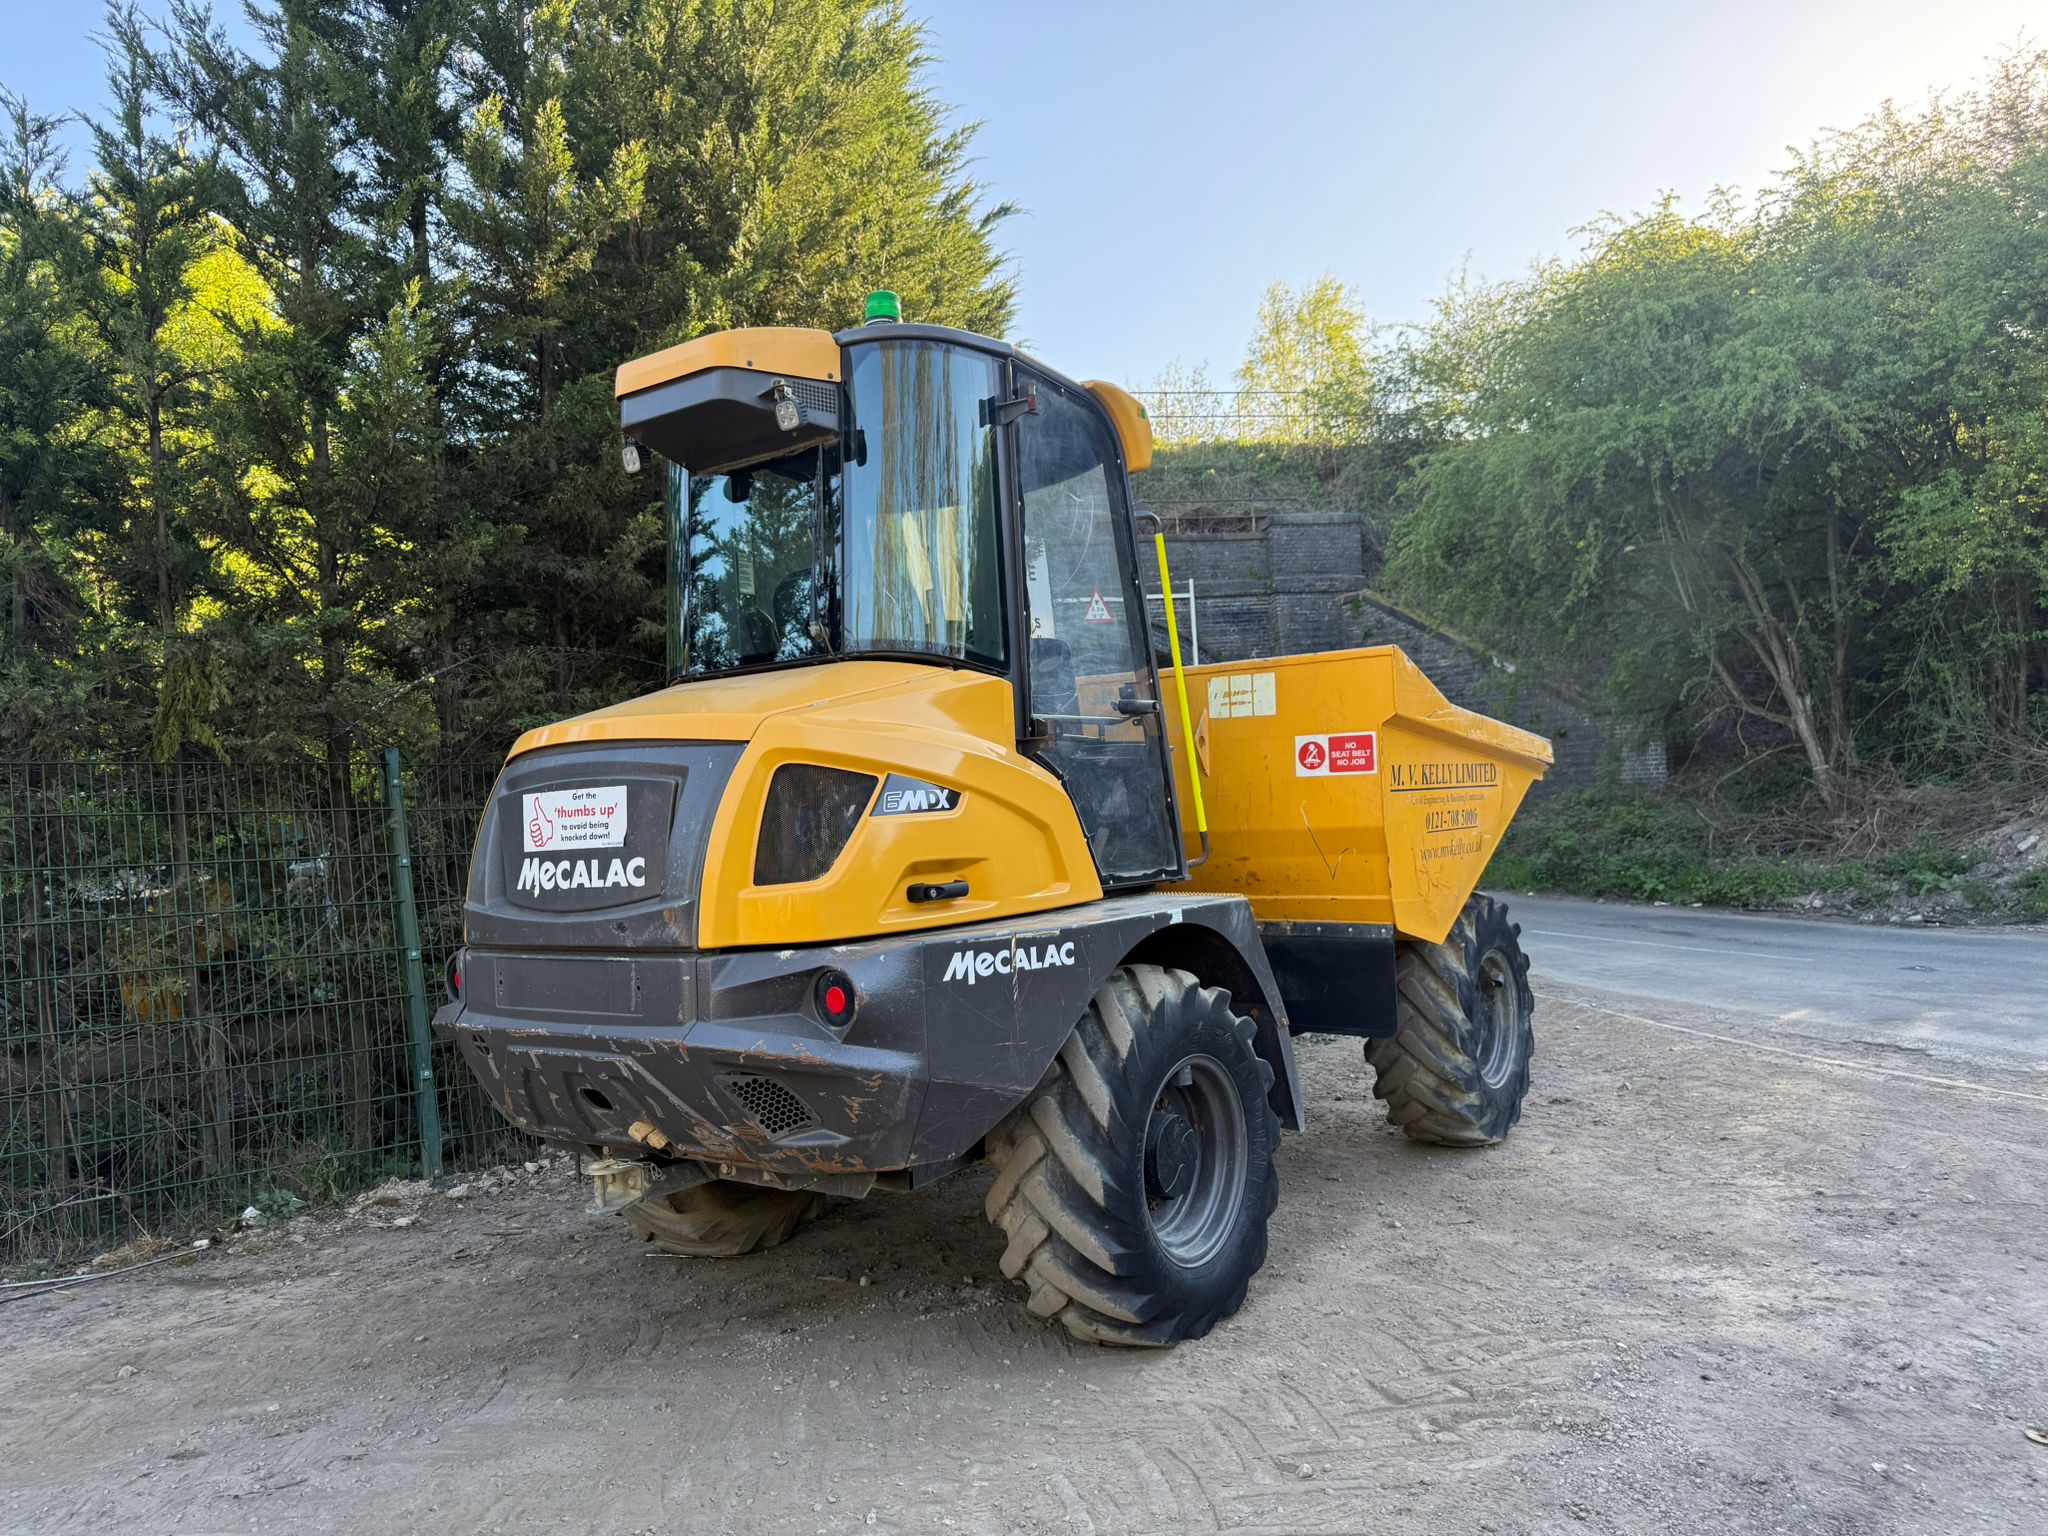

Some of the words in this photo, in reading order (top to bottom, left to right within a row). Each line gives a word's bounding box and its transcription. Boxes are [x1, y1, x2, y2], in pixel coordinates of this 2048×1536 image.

[1344, 741, 1357, 749] NO
[1331, 750, 1350, 758] SEAT
[1351, 749, 1371, 757] BELT
[1336, 758, 1349, 766] NO
[1350, 757, 1366, 765] JOB
[1390, 764, 1405, 787] M.
[1408, 764, 1418, 785] V.
[1421, 763, 1454, 785] KELLY
[1455, 763, 1497, 783] LIMITED
[572, 792, 585, 801] Get
[585, 791, 597, 800] the
[561, 823, 568, 831] to
[569, 821, 587, 830] avoid
[589, 821, 609, 830] being
[560, 832, 588, 842] knocked
[589, 831, 611, 840] down!
